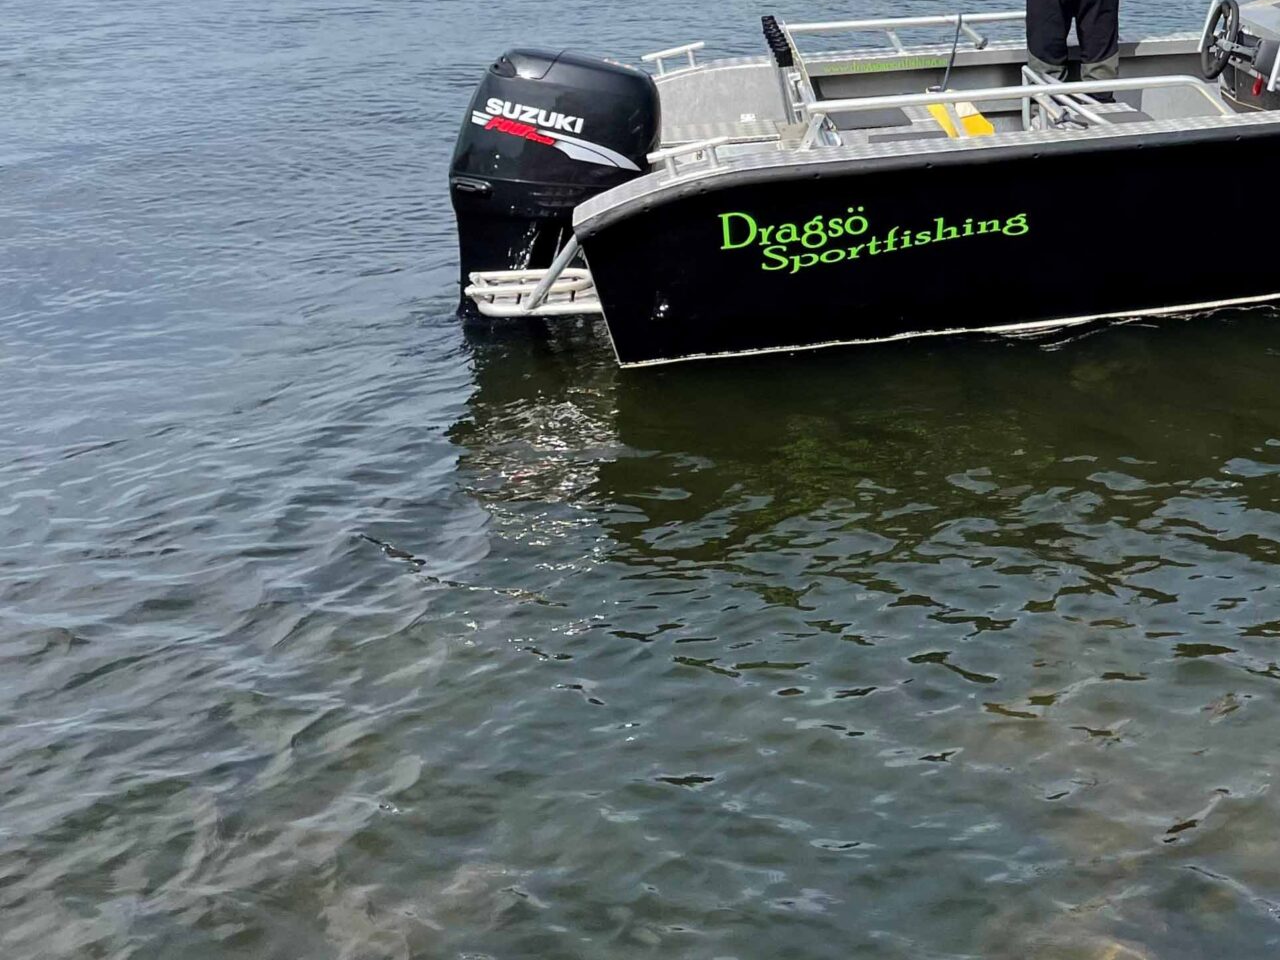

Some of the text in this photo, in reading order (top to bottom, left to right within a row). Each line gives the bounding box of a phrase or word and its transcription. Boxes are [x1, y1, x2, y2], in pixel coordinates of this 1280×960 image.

[485, 97, 584, 134] SUZUKI
[717, 206, 869, 250] Dragsö
[761, 213, 1030, 274] Sportfishing
